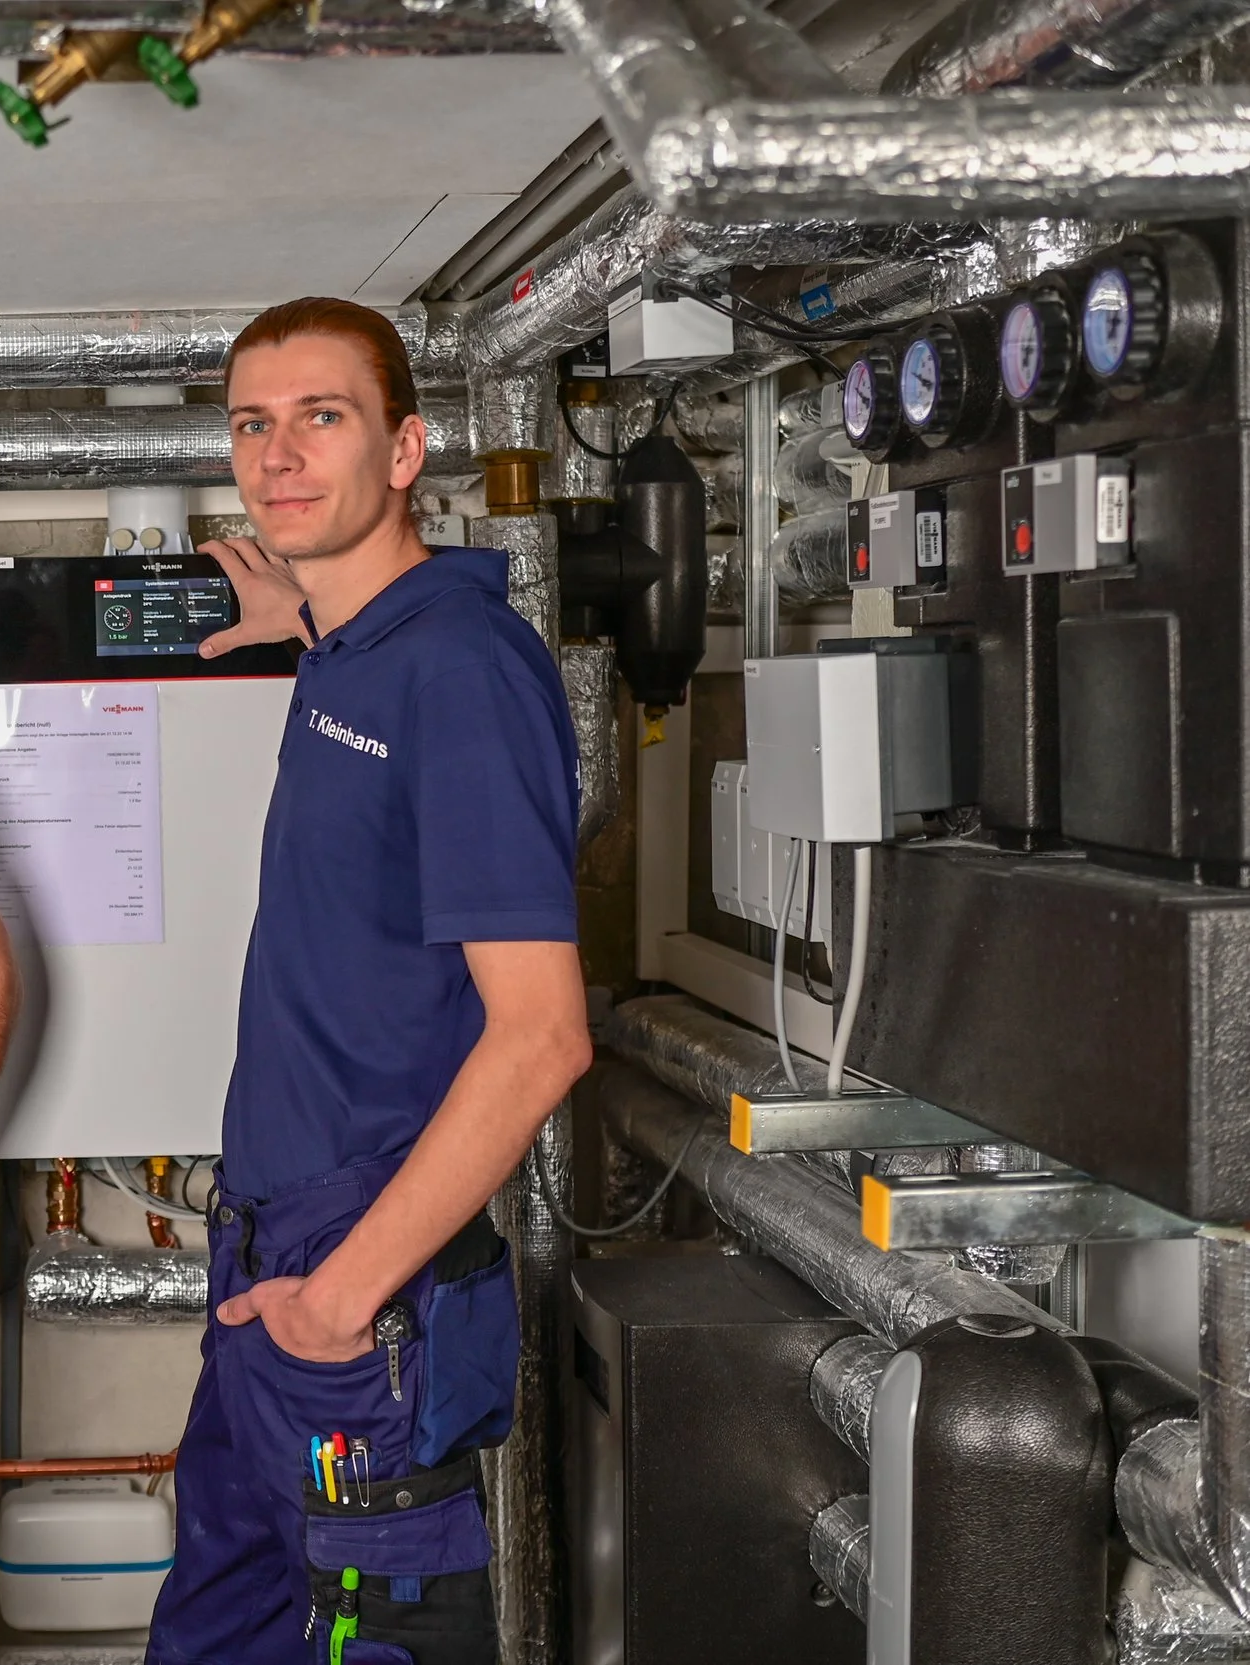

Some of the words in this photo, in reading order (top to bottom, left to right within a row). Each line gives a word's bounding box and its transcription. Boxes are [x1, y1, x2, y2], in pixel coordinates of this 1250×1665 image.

[142, 562, 183, 573] VIESSMANN
[102, 704, 144, 714] VIESSMANN
[308, 708, 319, 730] T.
[316, 713, 389, 759] Kleinhans
